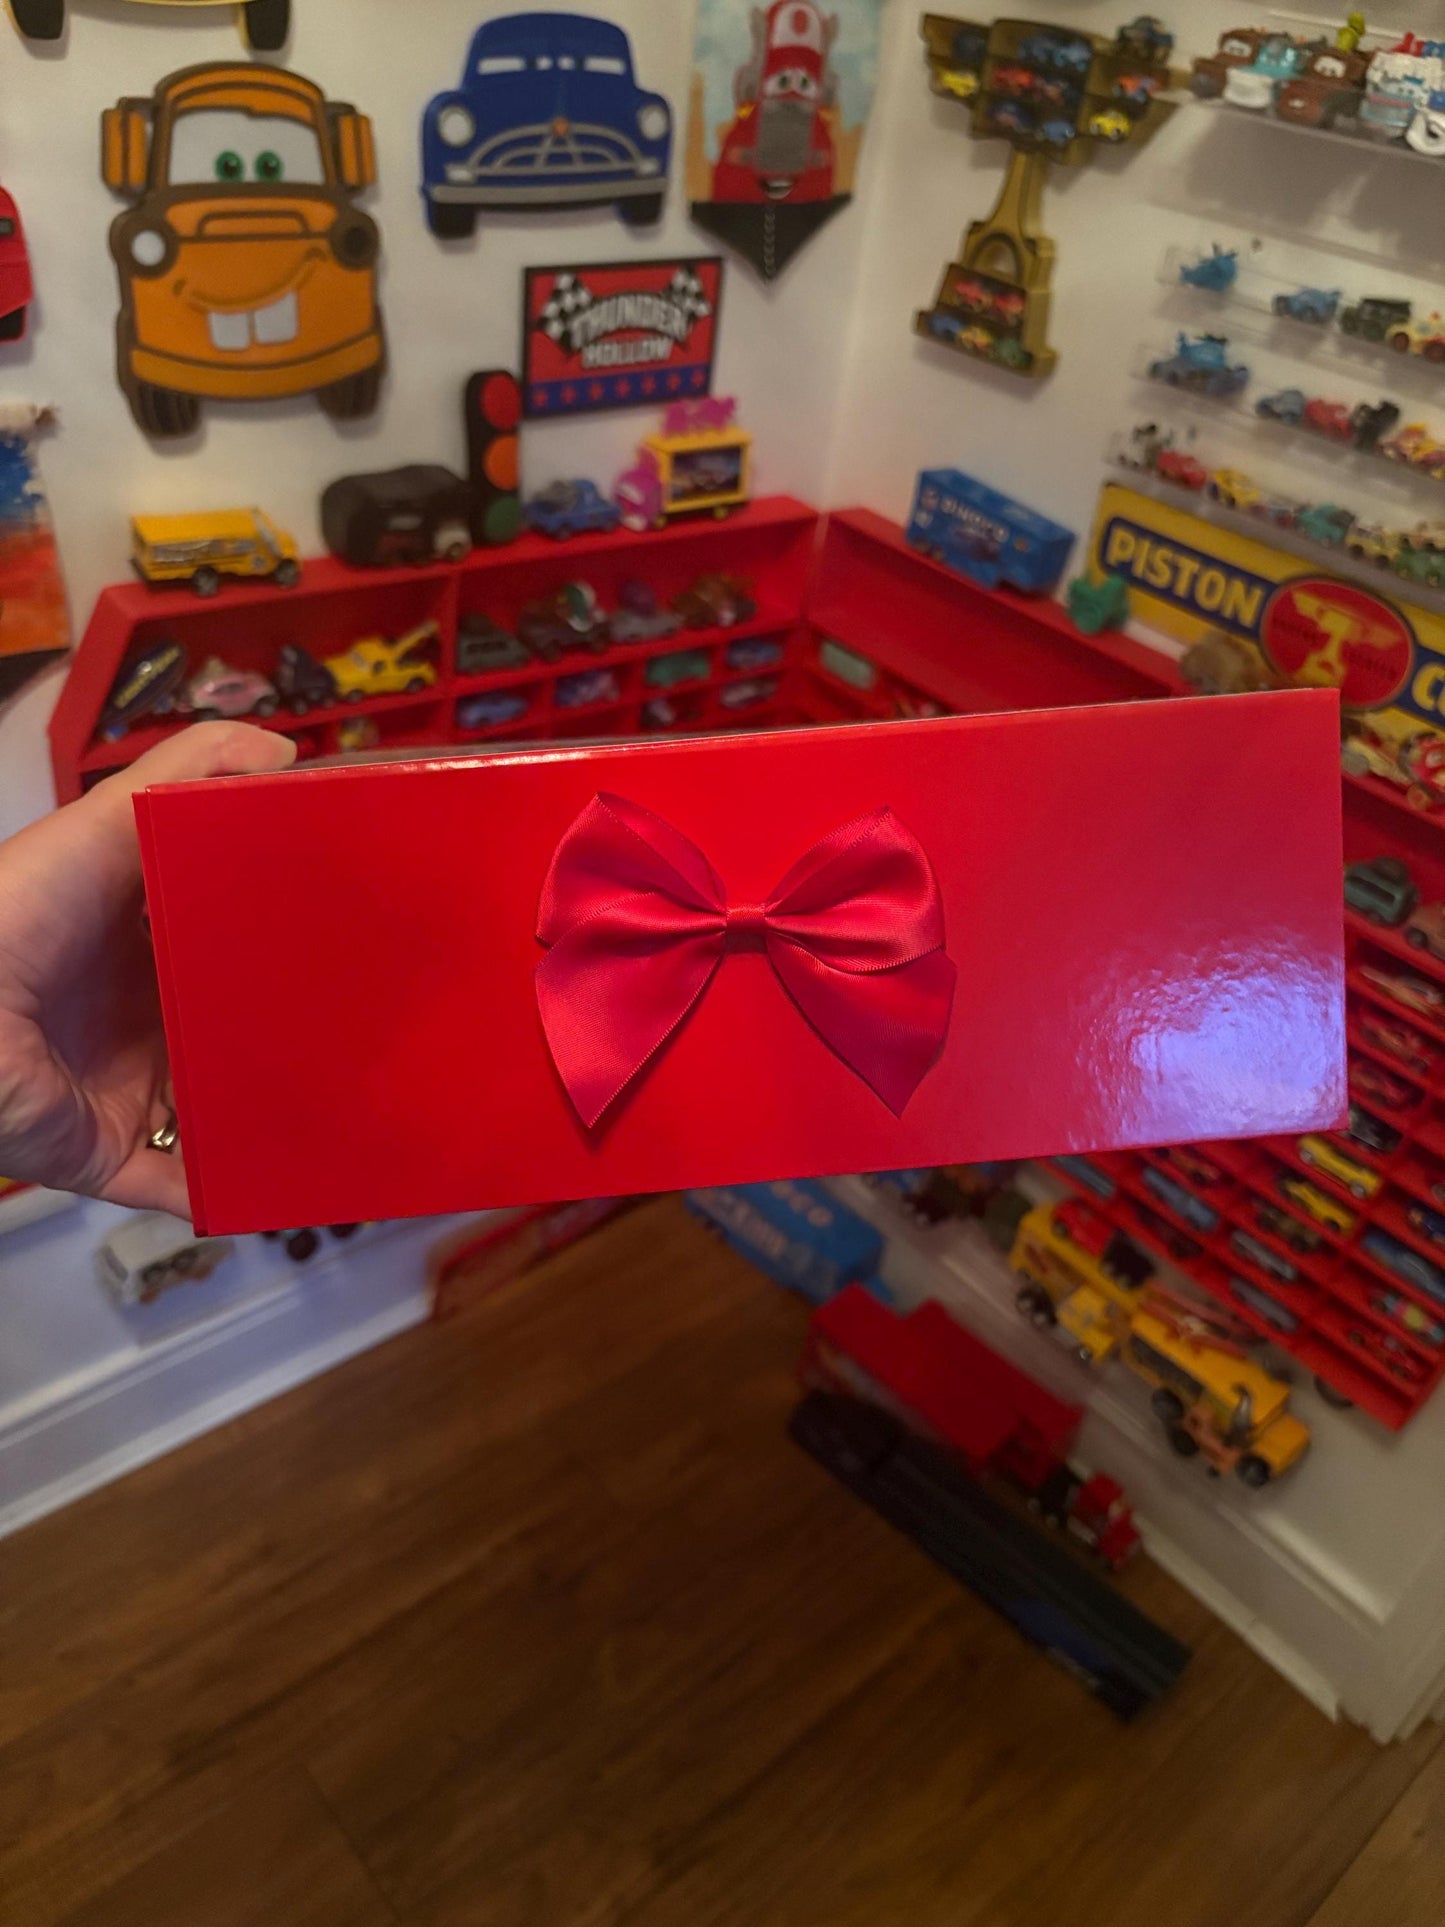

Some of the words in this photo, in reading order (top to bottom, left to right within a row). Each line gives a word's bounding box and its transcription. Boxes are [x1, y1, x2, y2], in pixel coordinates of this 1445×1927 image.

[581, 337, 673, 369] HOLLOW
[1105, 526, 1265, 629] PISTON
[1411, 662, 1445, 717] C
